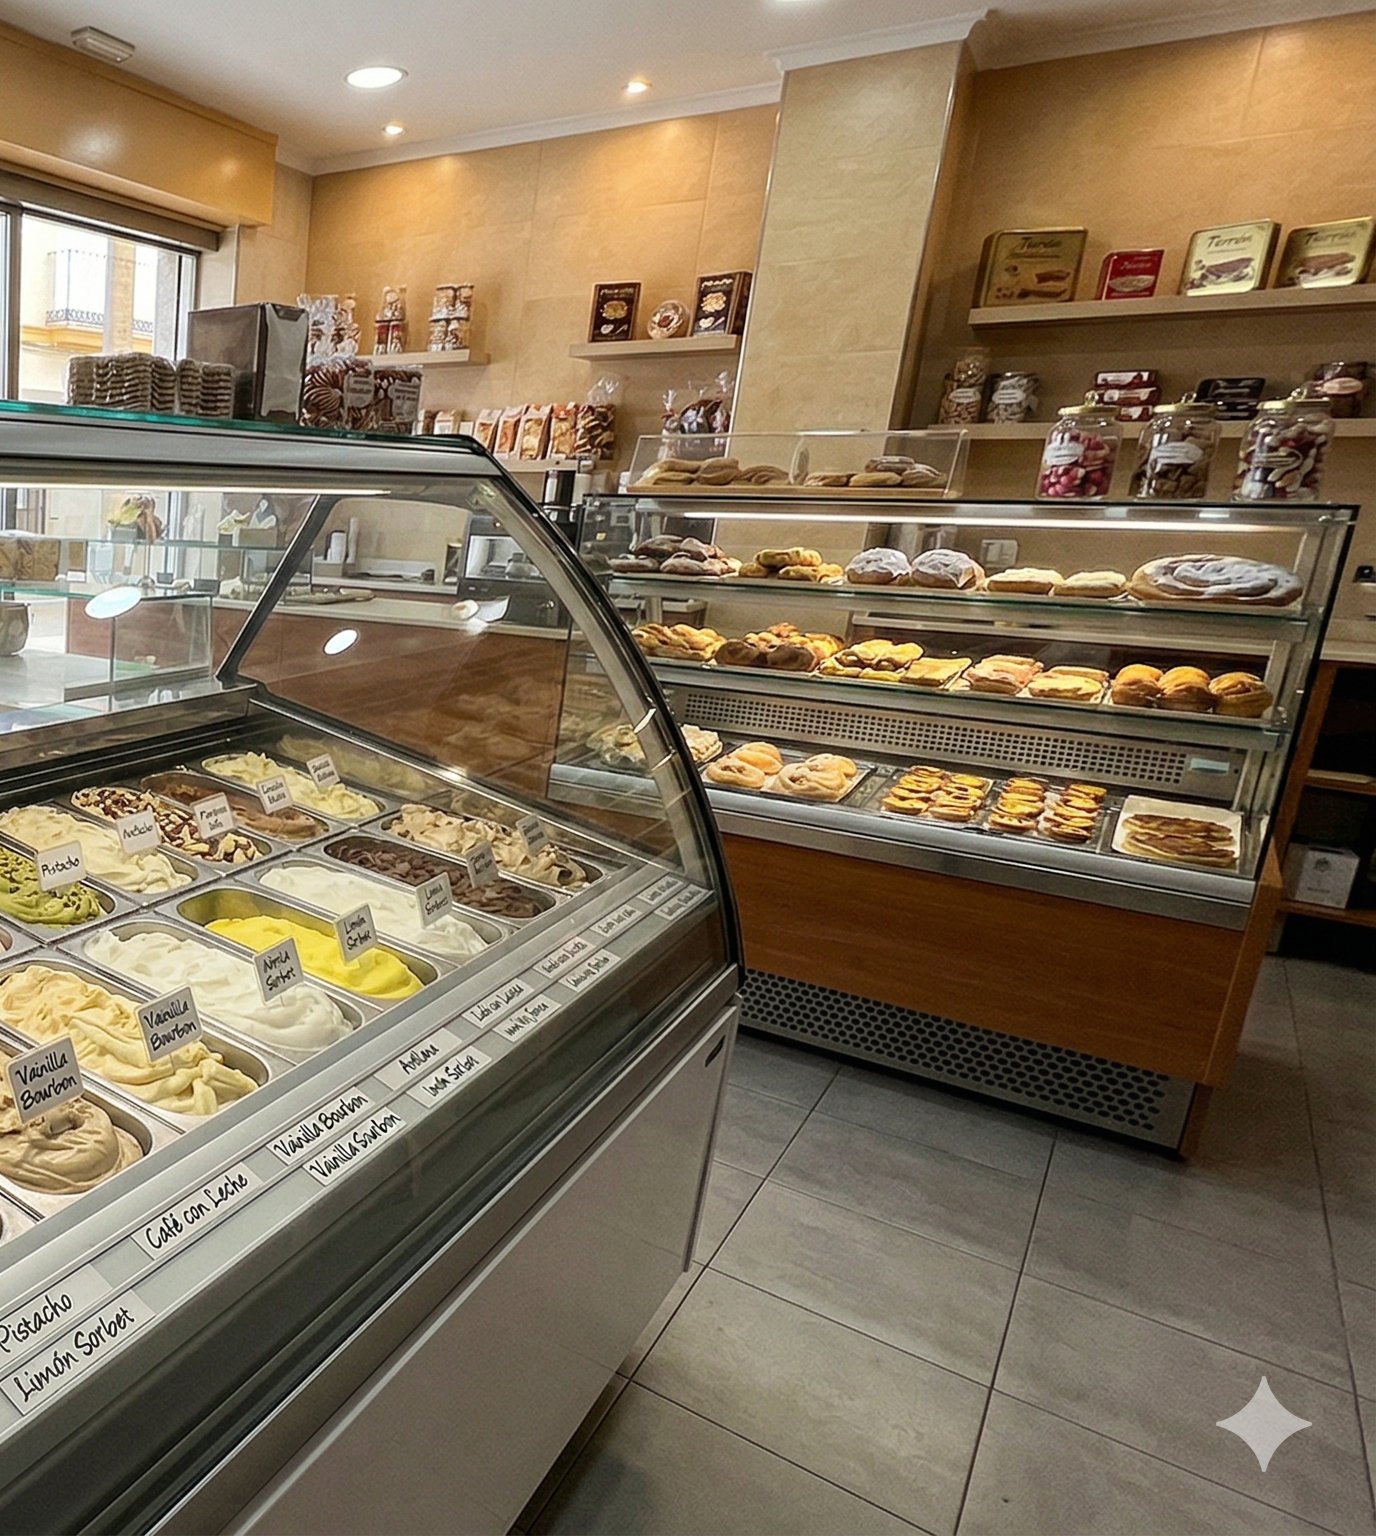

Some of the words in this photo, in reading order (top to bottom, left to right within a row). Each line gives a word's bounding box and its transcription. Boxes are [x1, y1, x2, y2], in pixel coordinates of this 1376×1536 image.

[15, 1051, 68, 1085] Vainilla
[20, 1075, 77, 1110] Bourbon
[146, 1213, 183, 1249] Café
[184, 1202, 211, 1225] con
[203, 1174, 248, 1208] Leche
[74, 1307, 135, 1356] Sorbet
